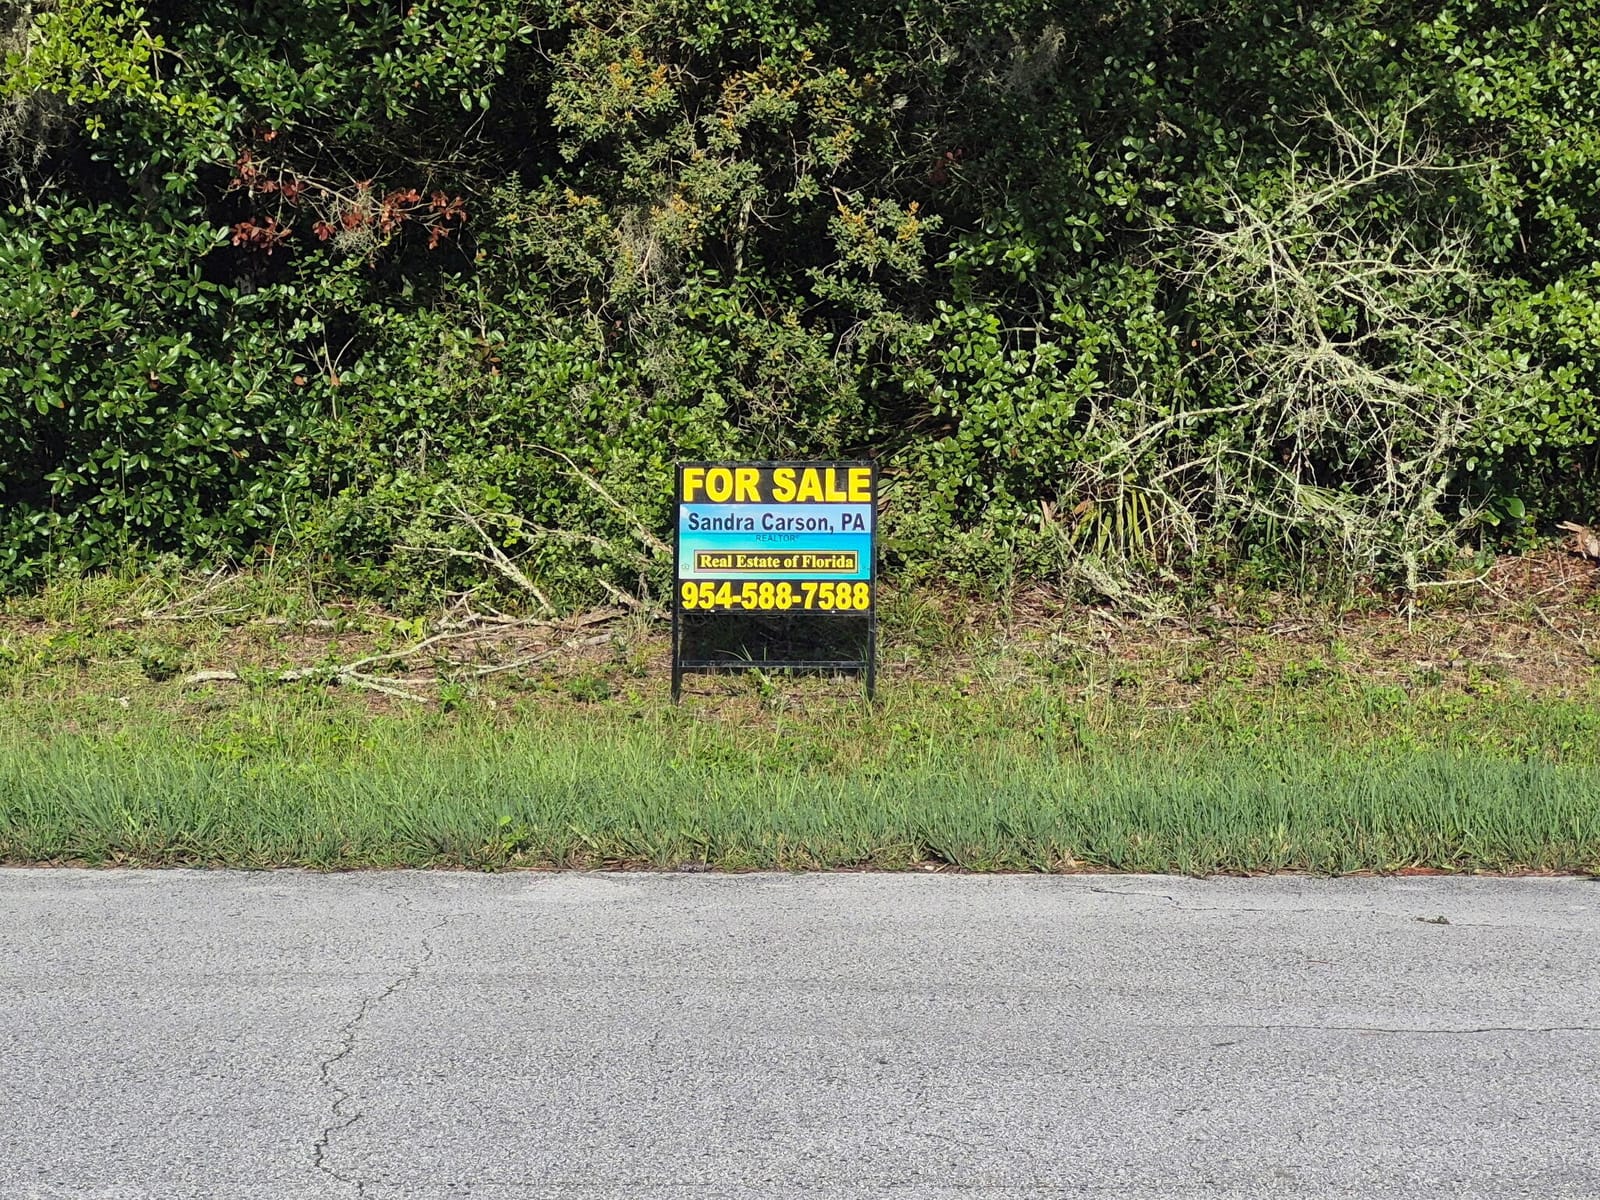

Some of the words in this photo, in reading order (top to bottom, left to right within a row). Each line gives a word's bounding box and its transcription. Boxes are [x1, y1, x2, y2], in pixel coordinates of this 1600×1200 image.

[683, 468, 761, 502] FOR
[772, 468, 871, 502] SALE
[688, 512, 754, 531] Sandra
[762, 512, 834, 534] Carson,
[841, 513, 865, 531] PA
[700, 555, 732, 568] Real
[736, 555, 779, 568] Estate
[783, 555, 798, 568] of
[802, 555, 854, 568] Florida
[681, 582, 870, 609] 954-588-7588
